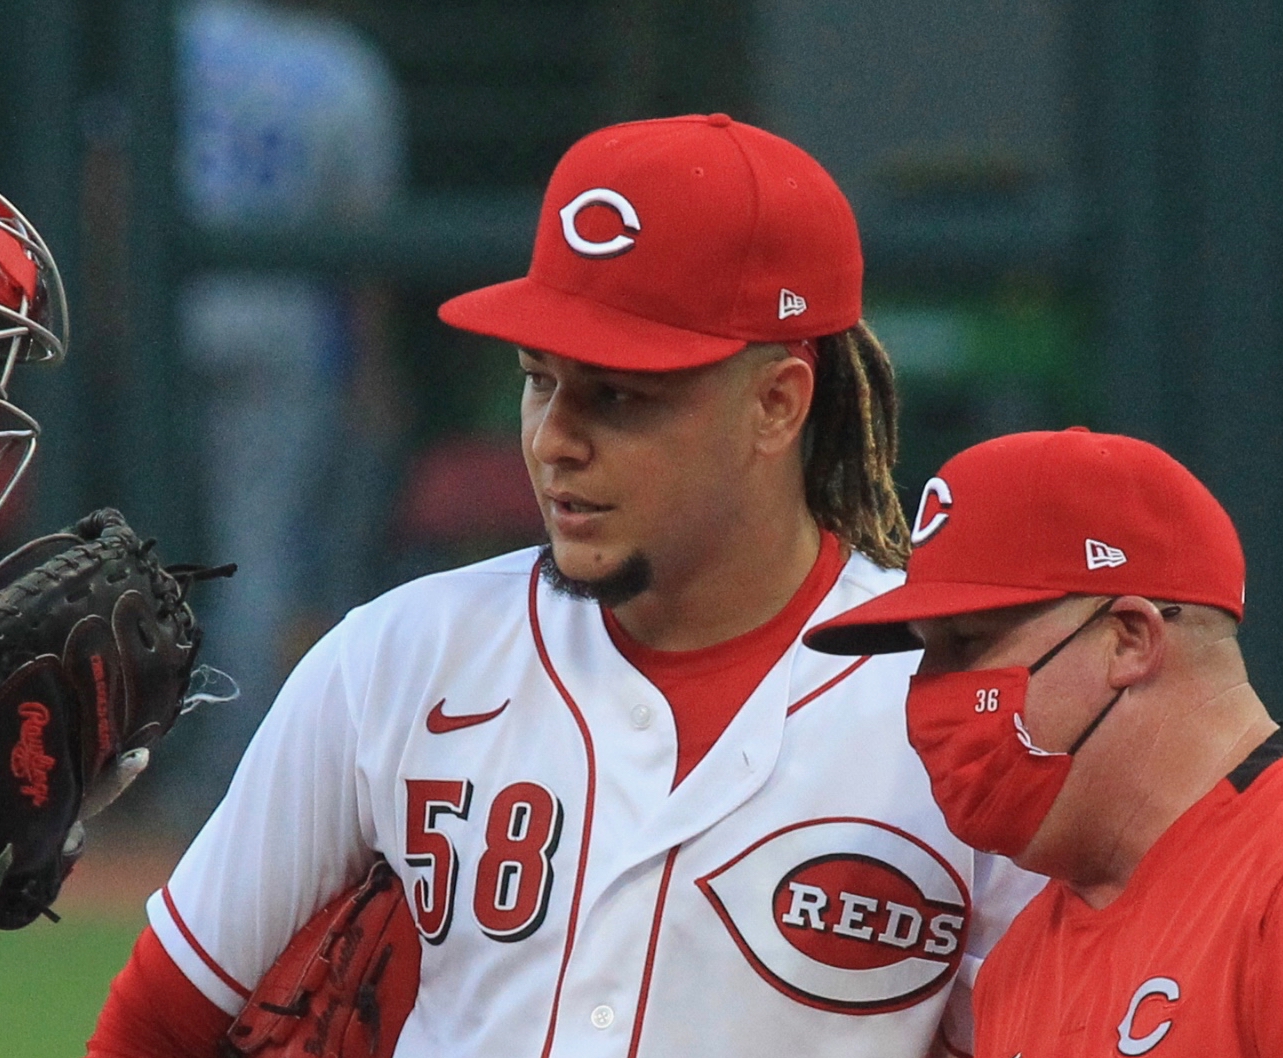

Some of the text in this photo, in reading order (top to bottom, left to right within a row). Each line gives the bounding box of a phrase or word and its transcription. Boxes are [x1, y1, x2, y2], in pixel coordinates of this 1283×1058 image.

[559, 187, 641, 258] C
[911, 477, 953, 547] C
[974, 688, 999, 713] 36
[402, 778, 564, 946] 58
[782, 881, 964, 956] REDS
[1117, 976, 1180, 1056] C
